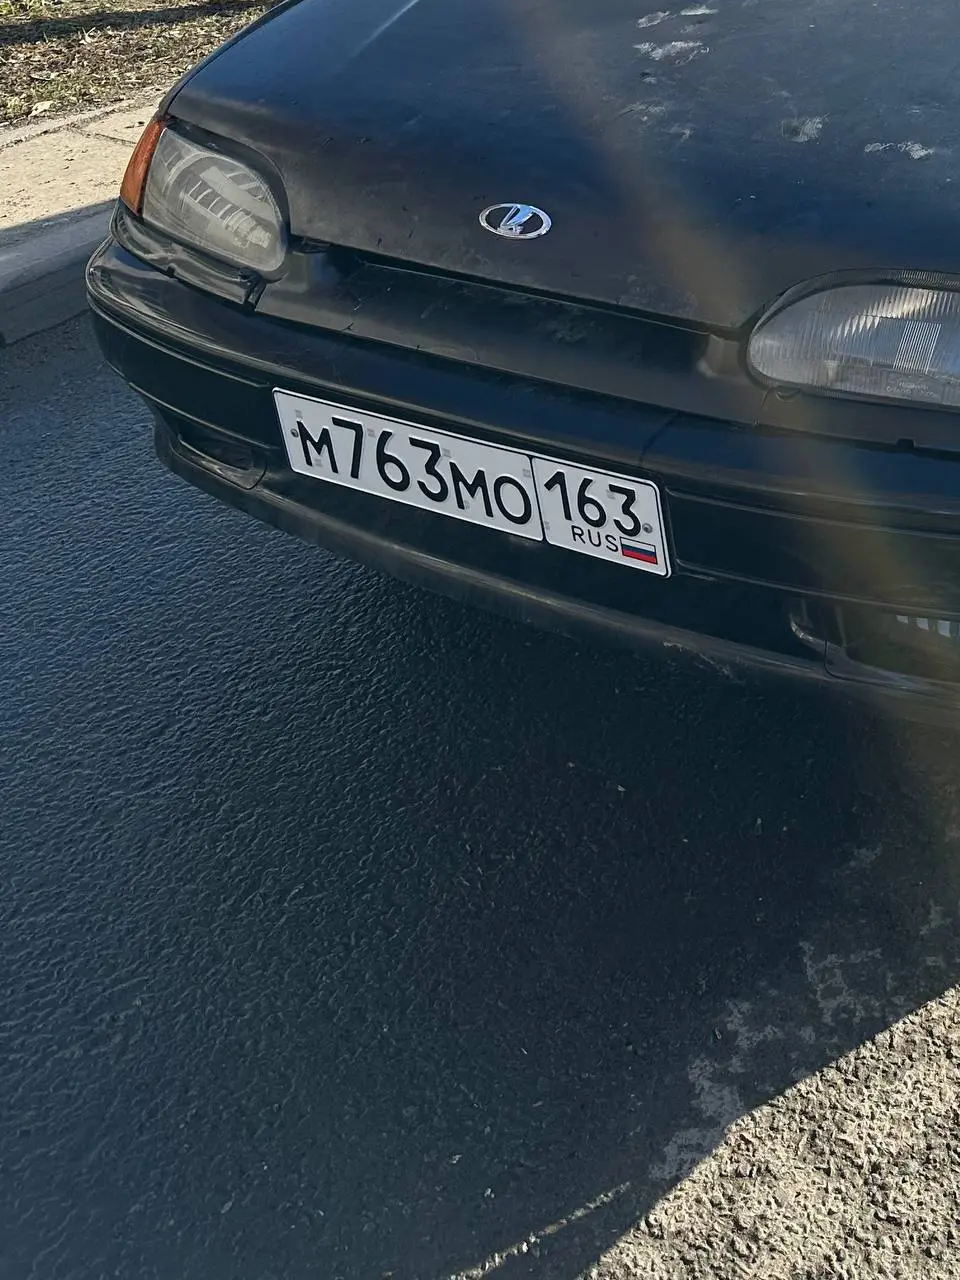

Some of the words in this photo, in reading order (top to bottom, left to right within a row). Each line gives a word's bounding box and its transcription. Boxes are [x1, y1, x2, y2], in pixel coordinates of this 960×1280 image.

[296, 416, 533, 526] М763МО
[544, 470, 643, 537] 163
[570, 524, 620, 553] RUS
